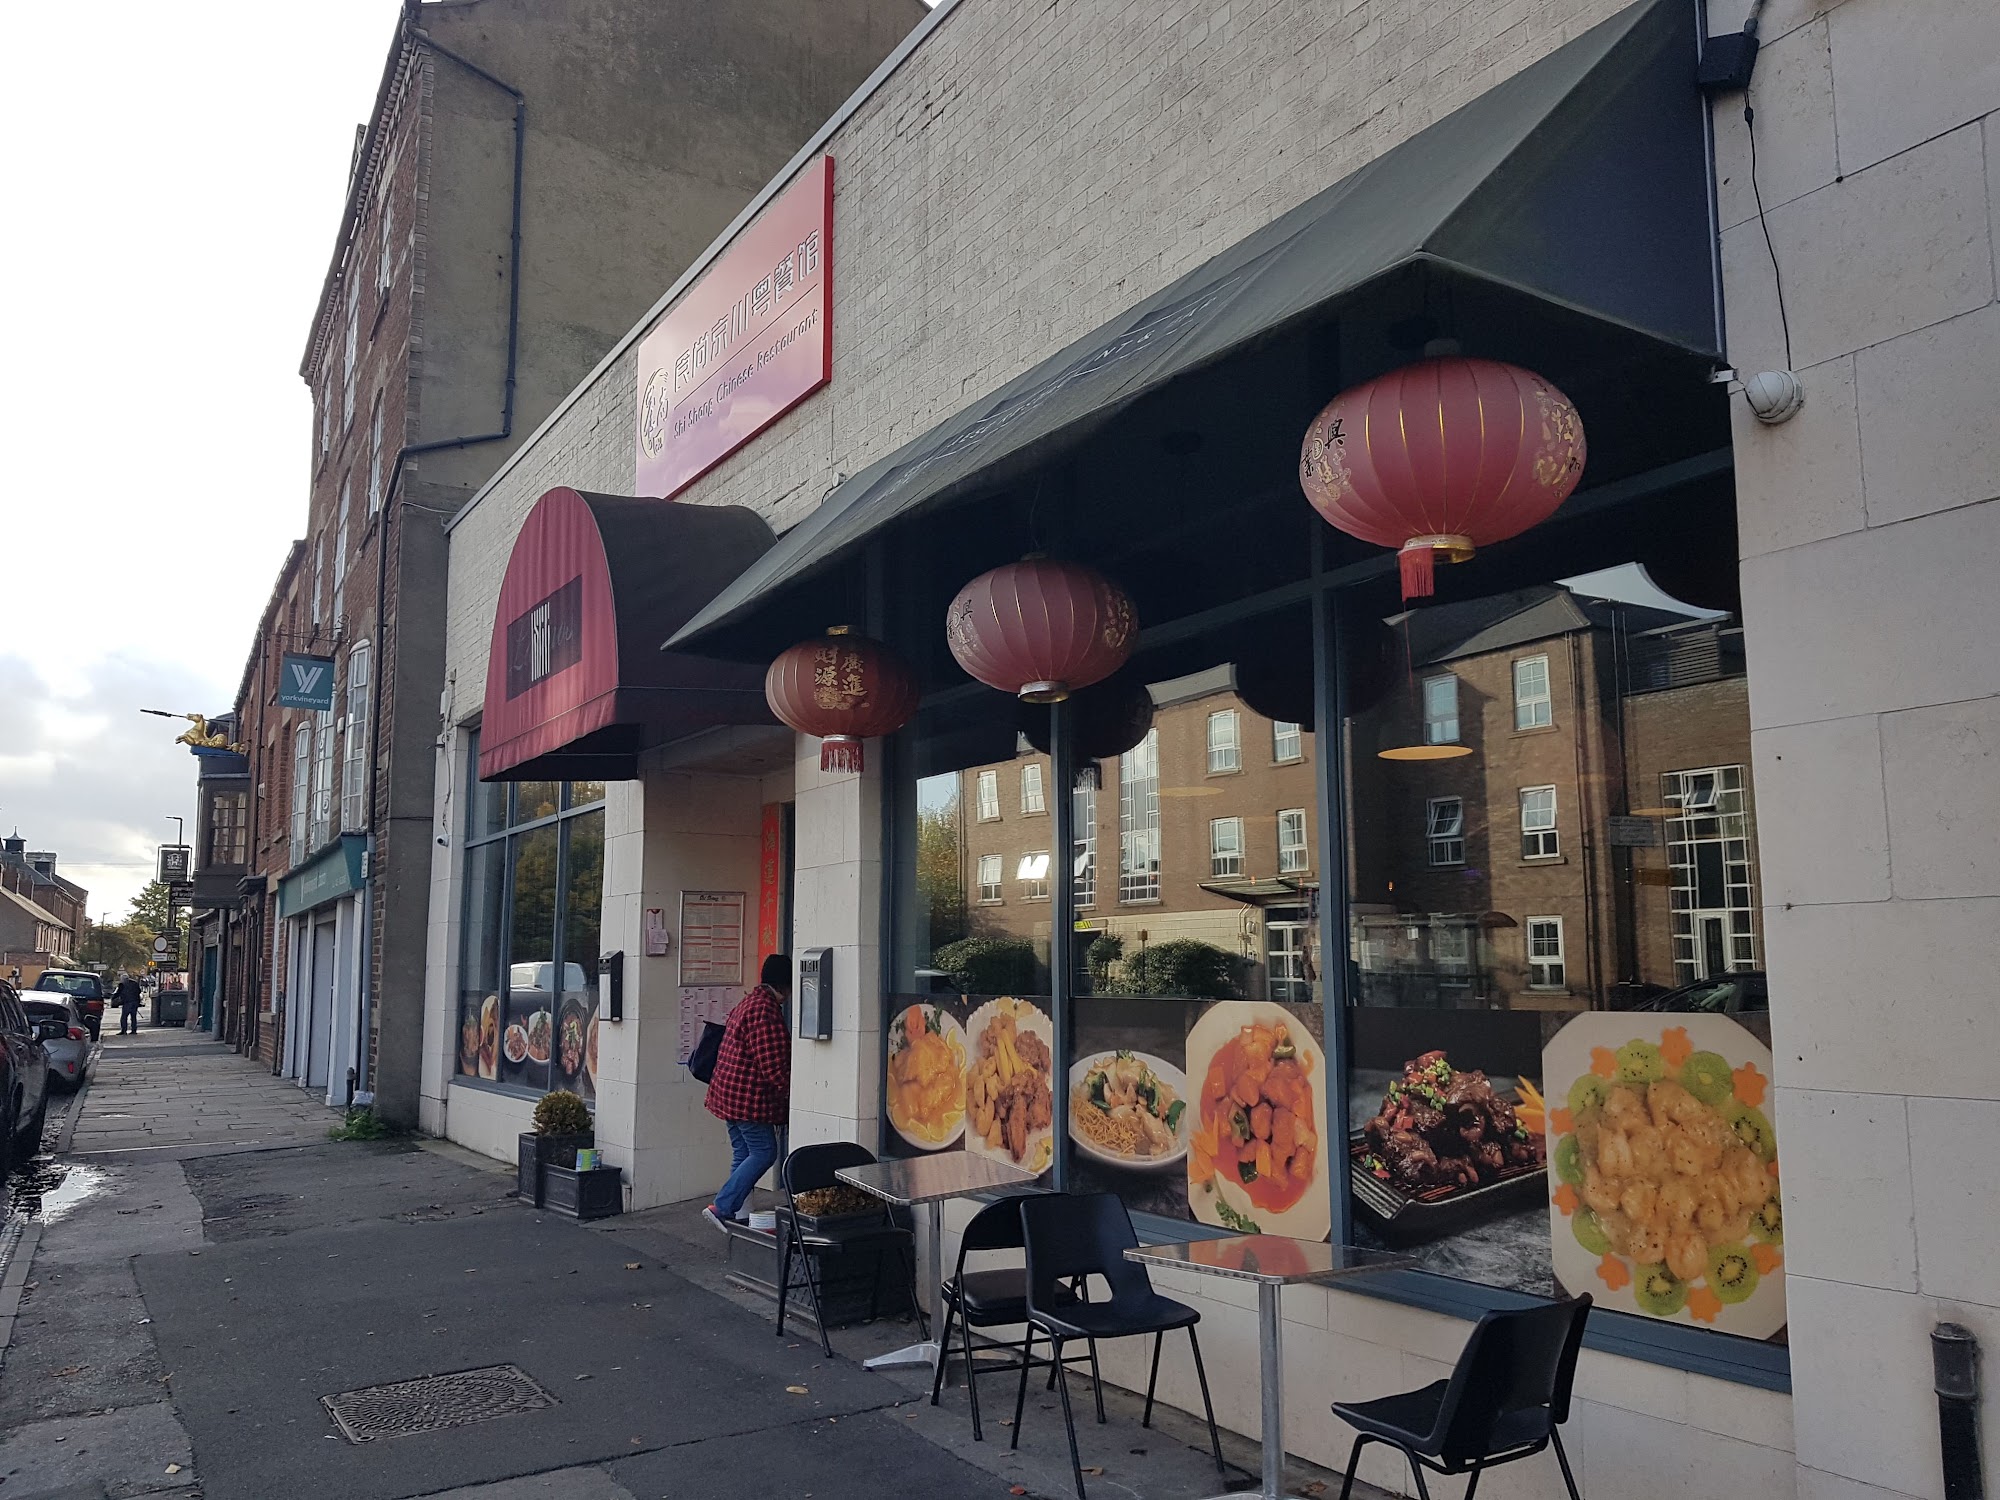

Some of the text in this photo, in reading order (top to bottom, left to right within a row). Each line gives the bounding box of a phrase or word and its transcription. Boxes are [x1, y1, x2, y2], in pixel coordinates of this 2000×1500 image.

[674, 308, 819, 439] Shi Shang Chinese Restaurant
[281, 694, 329, 705] yorkvineyard
